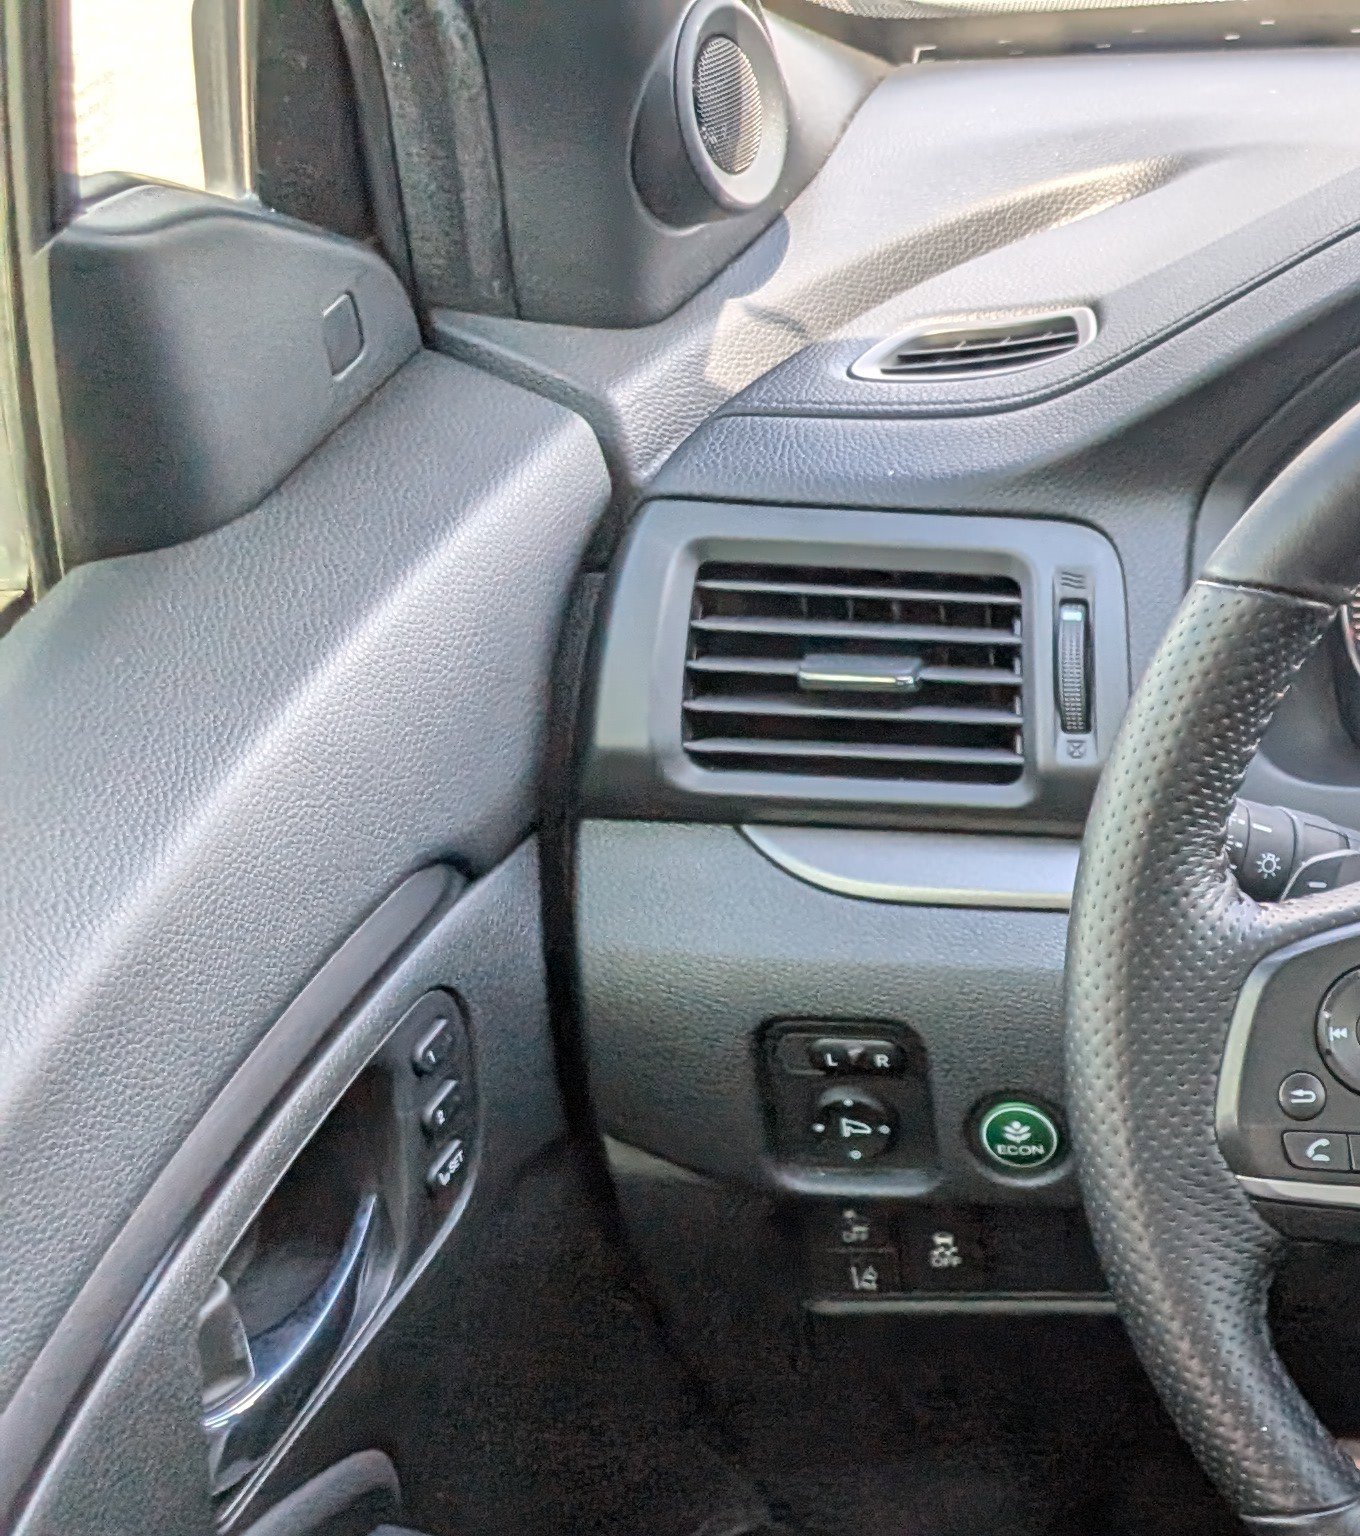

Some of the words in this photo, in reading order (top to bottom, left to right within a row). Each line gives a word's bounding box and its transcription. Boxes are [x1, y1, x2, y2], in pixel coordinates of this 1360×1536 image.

[826, 1053, 838, 1067] L
[875, 1053, 890, 1068] R
[996, 1143, 1045, 1157] ECON
